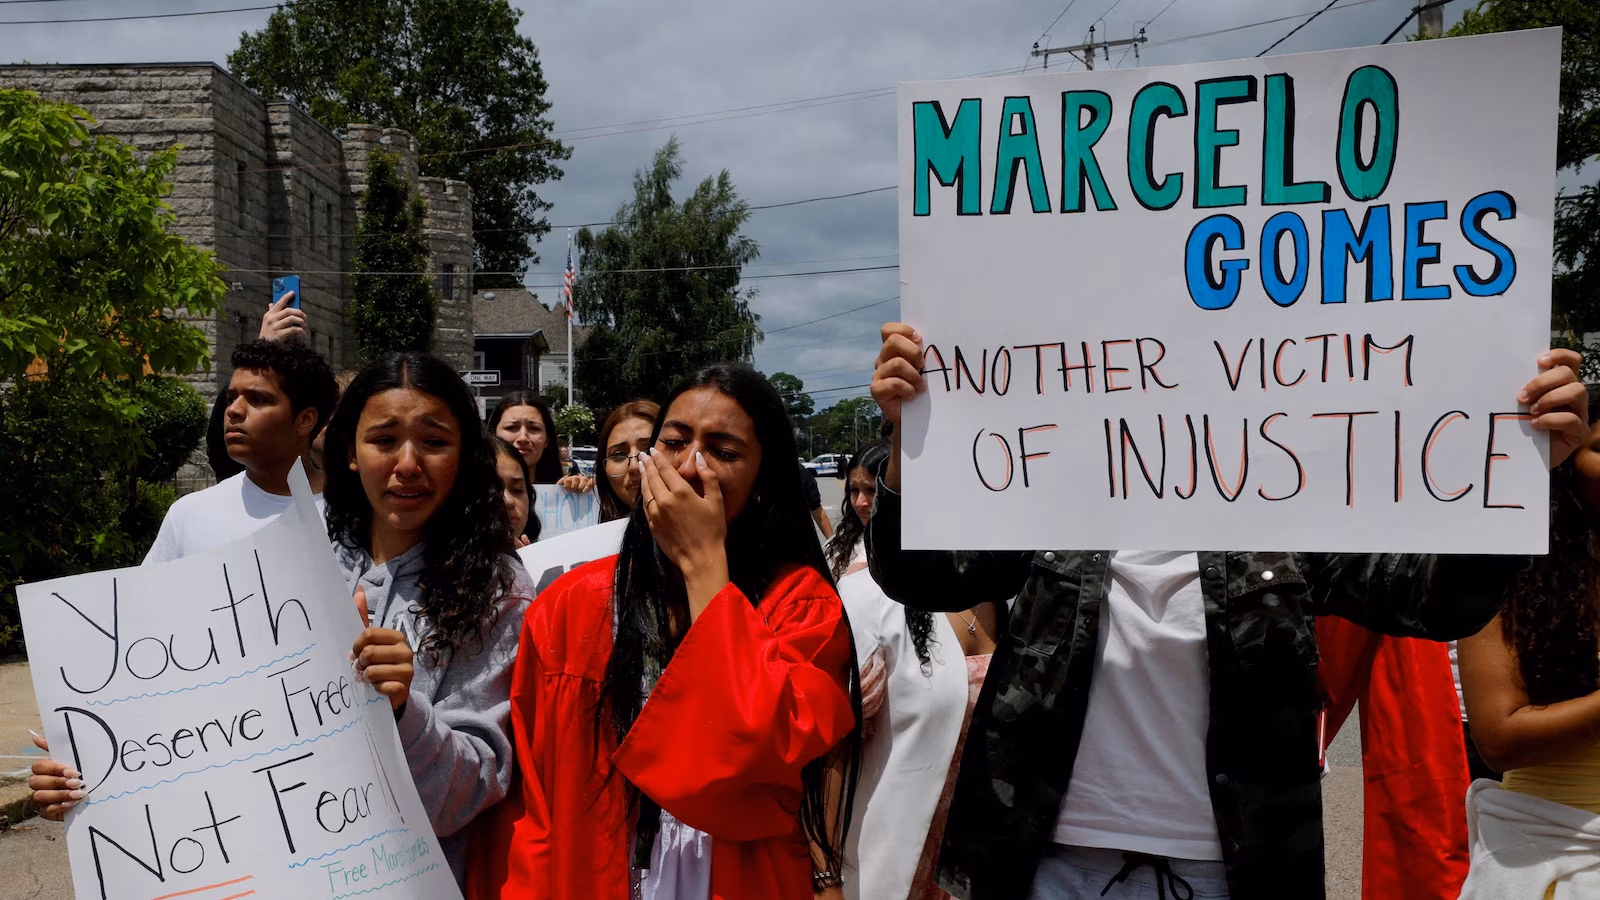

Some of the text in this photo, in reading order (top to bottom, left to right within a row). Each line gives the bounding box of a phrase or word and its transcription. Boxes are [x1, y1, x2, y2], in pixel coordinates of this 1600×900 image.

[913, 65, 1398, 216] MARCELO
[1184, 190, 1517, 310] GOMES
[919, 333, 1413, 396] ANOTHER VICTIM
[972, 410, 1532, 509] OF INJUSTICE
[51, 550, 312, 694] Youth
[53, 706, 264, 798] Deserve
[88, 791, 241, 900] Not
[319, 860, 368, 893] Free
